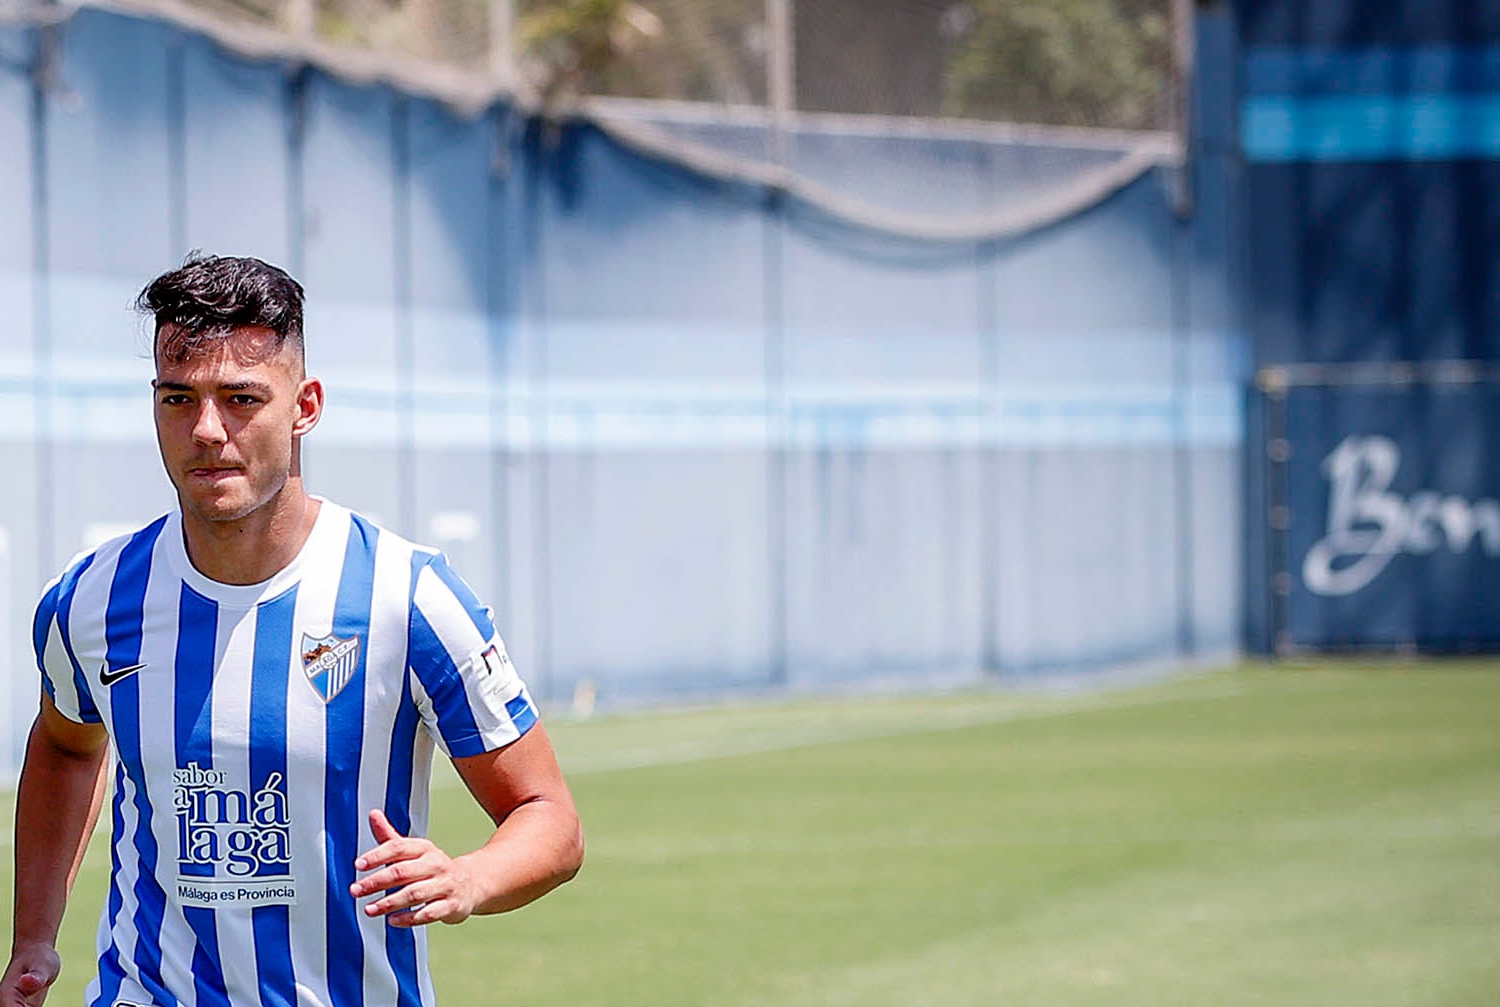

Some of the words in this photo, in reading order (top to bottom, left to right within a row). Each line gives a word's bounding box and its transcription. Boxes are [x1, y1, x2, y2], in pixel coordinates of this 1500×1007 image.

[172, 761, 228, 785] sabor
[175, 811, 292, 875] laga
[178, 885, 218, 903] Málaga
[219, 890, 236, 901] es
[237, 885, 295, 900] Provincia
